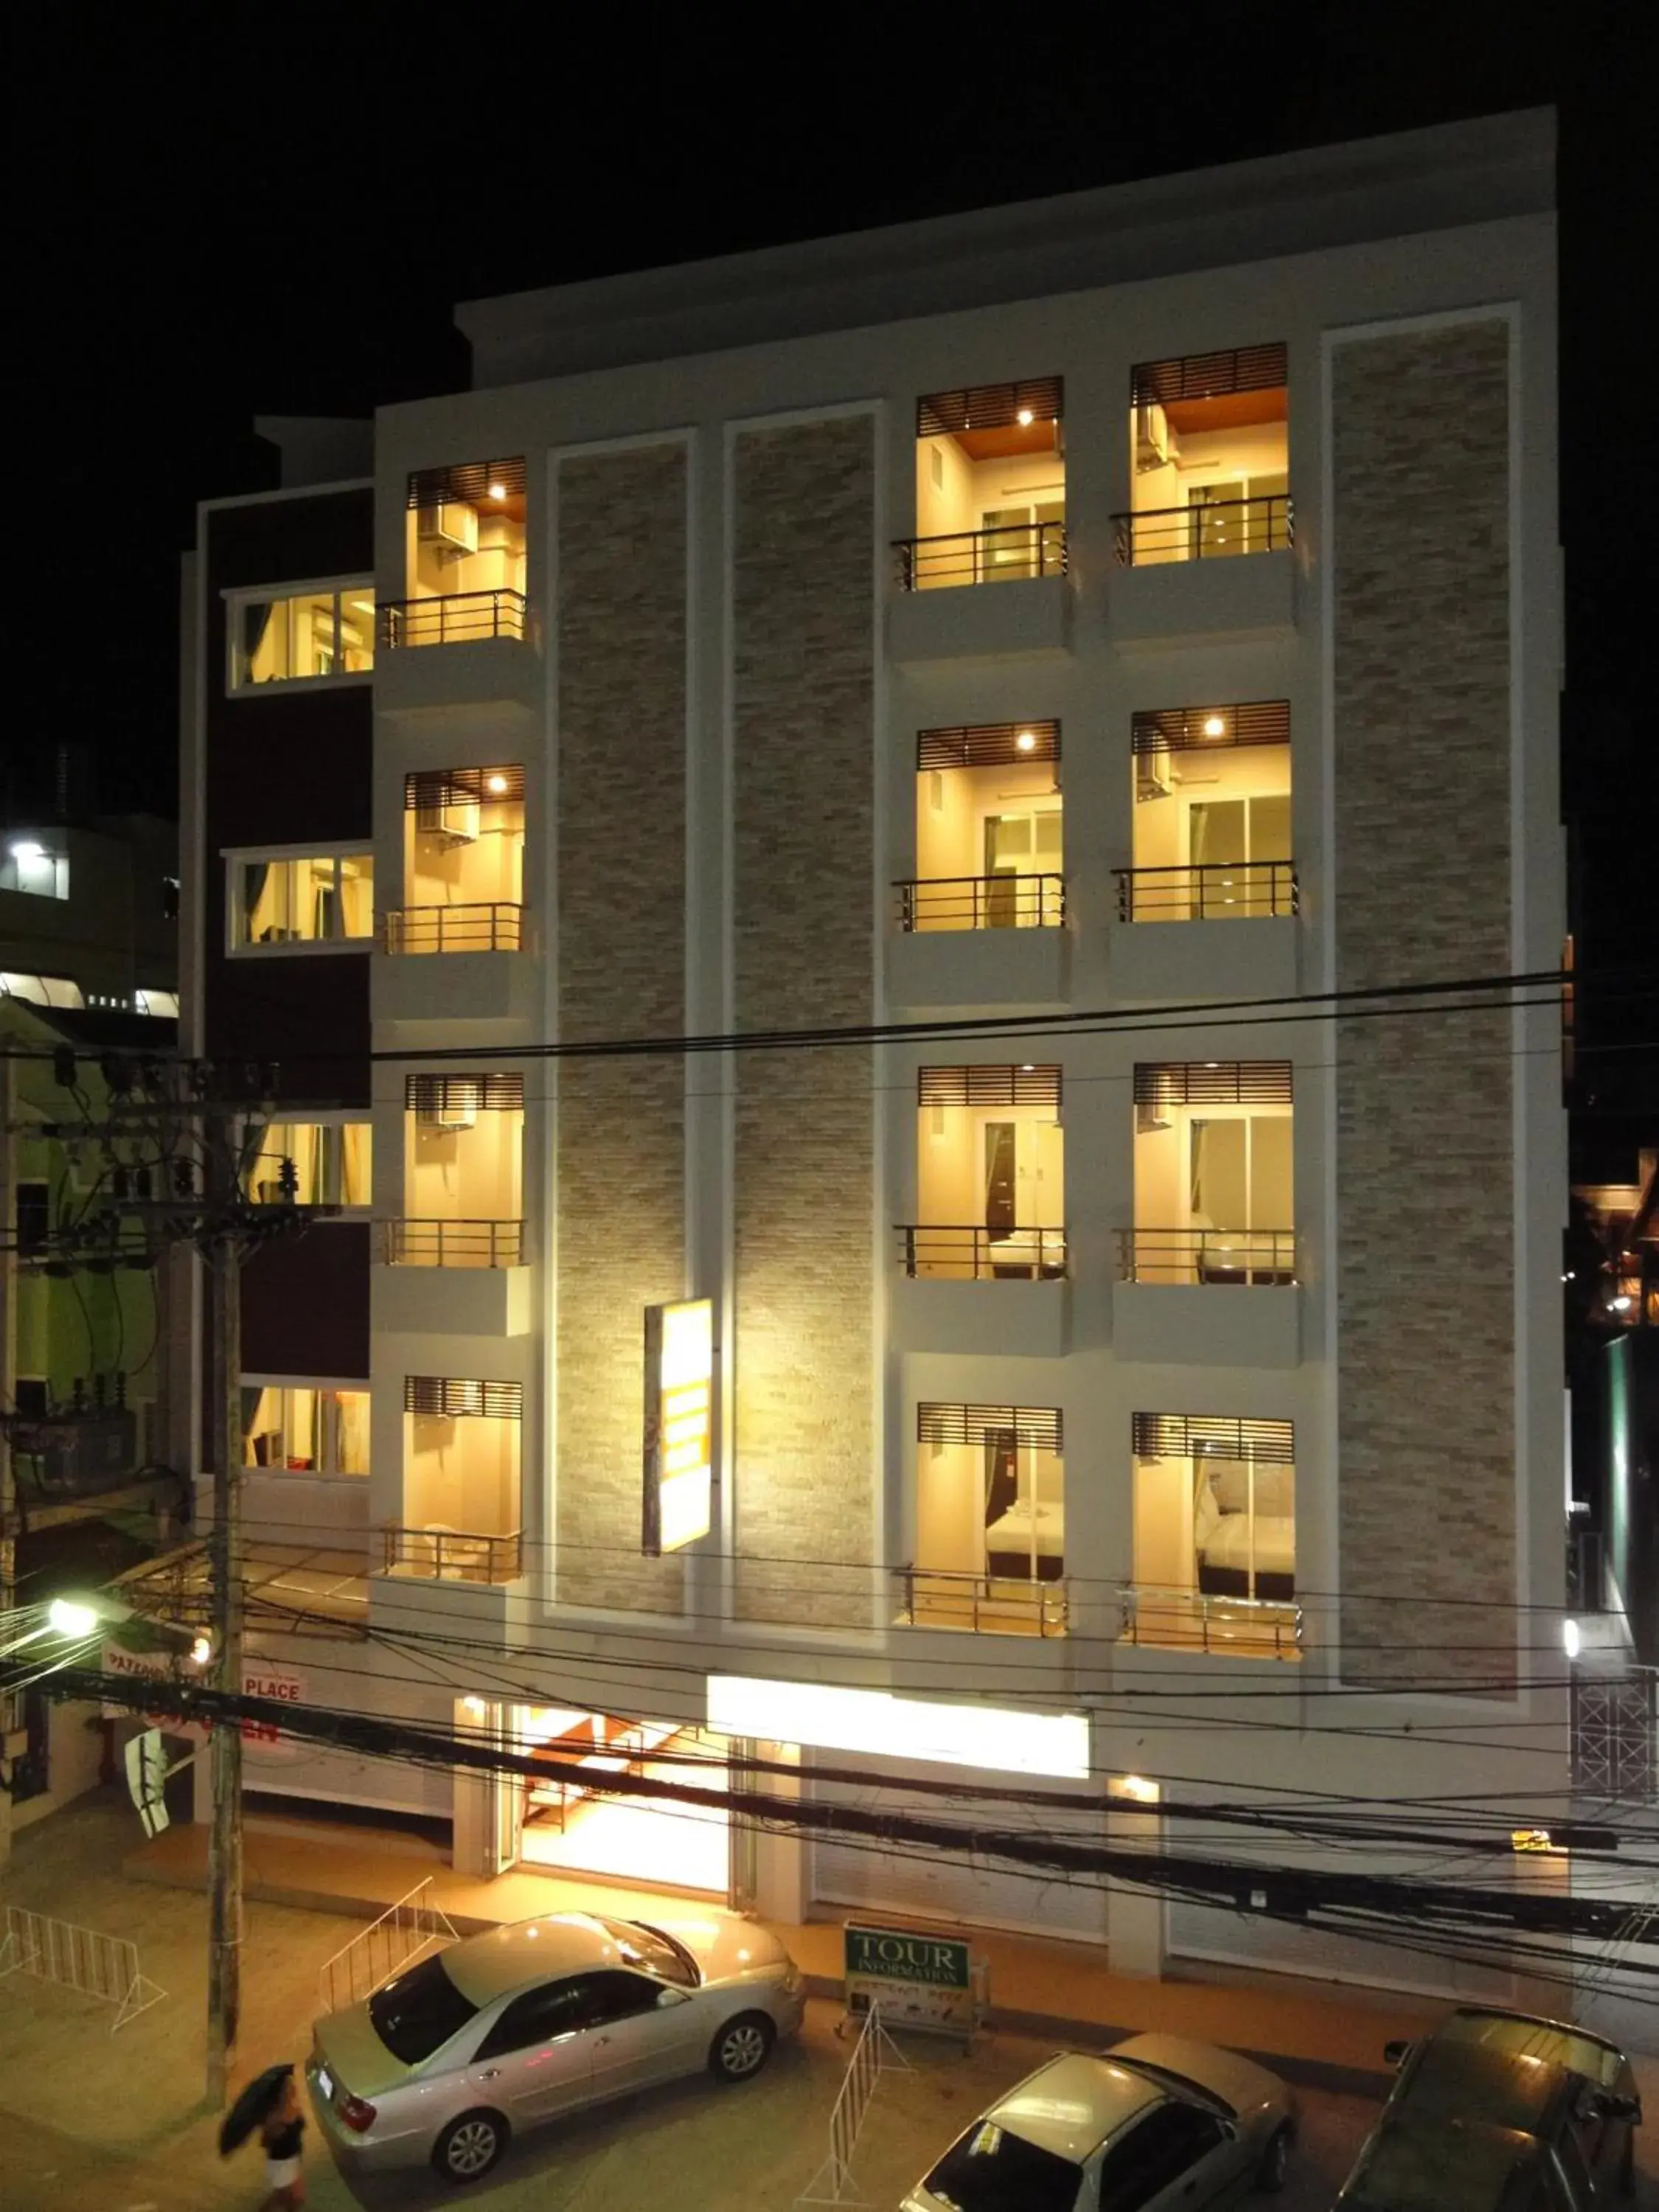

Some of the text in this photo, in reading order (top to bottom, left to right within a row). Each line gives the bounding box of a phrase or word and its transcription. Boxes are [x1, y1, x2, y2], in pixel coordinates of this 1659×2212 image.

[246, 1680, 299, 1700] PLACE
[853, 1935, 956, 1970] TOUR
[858, 1958, 958, 1983] INFORMATION
